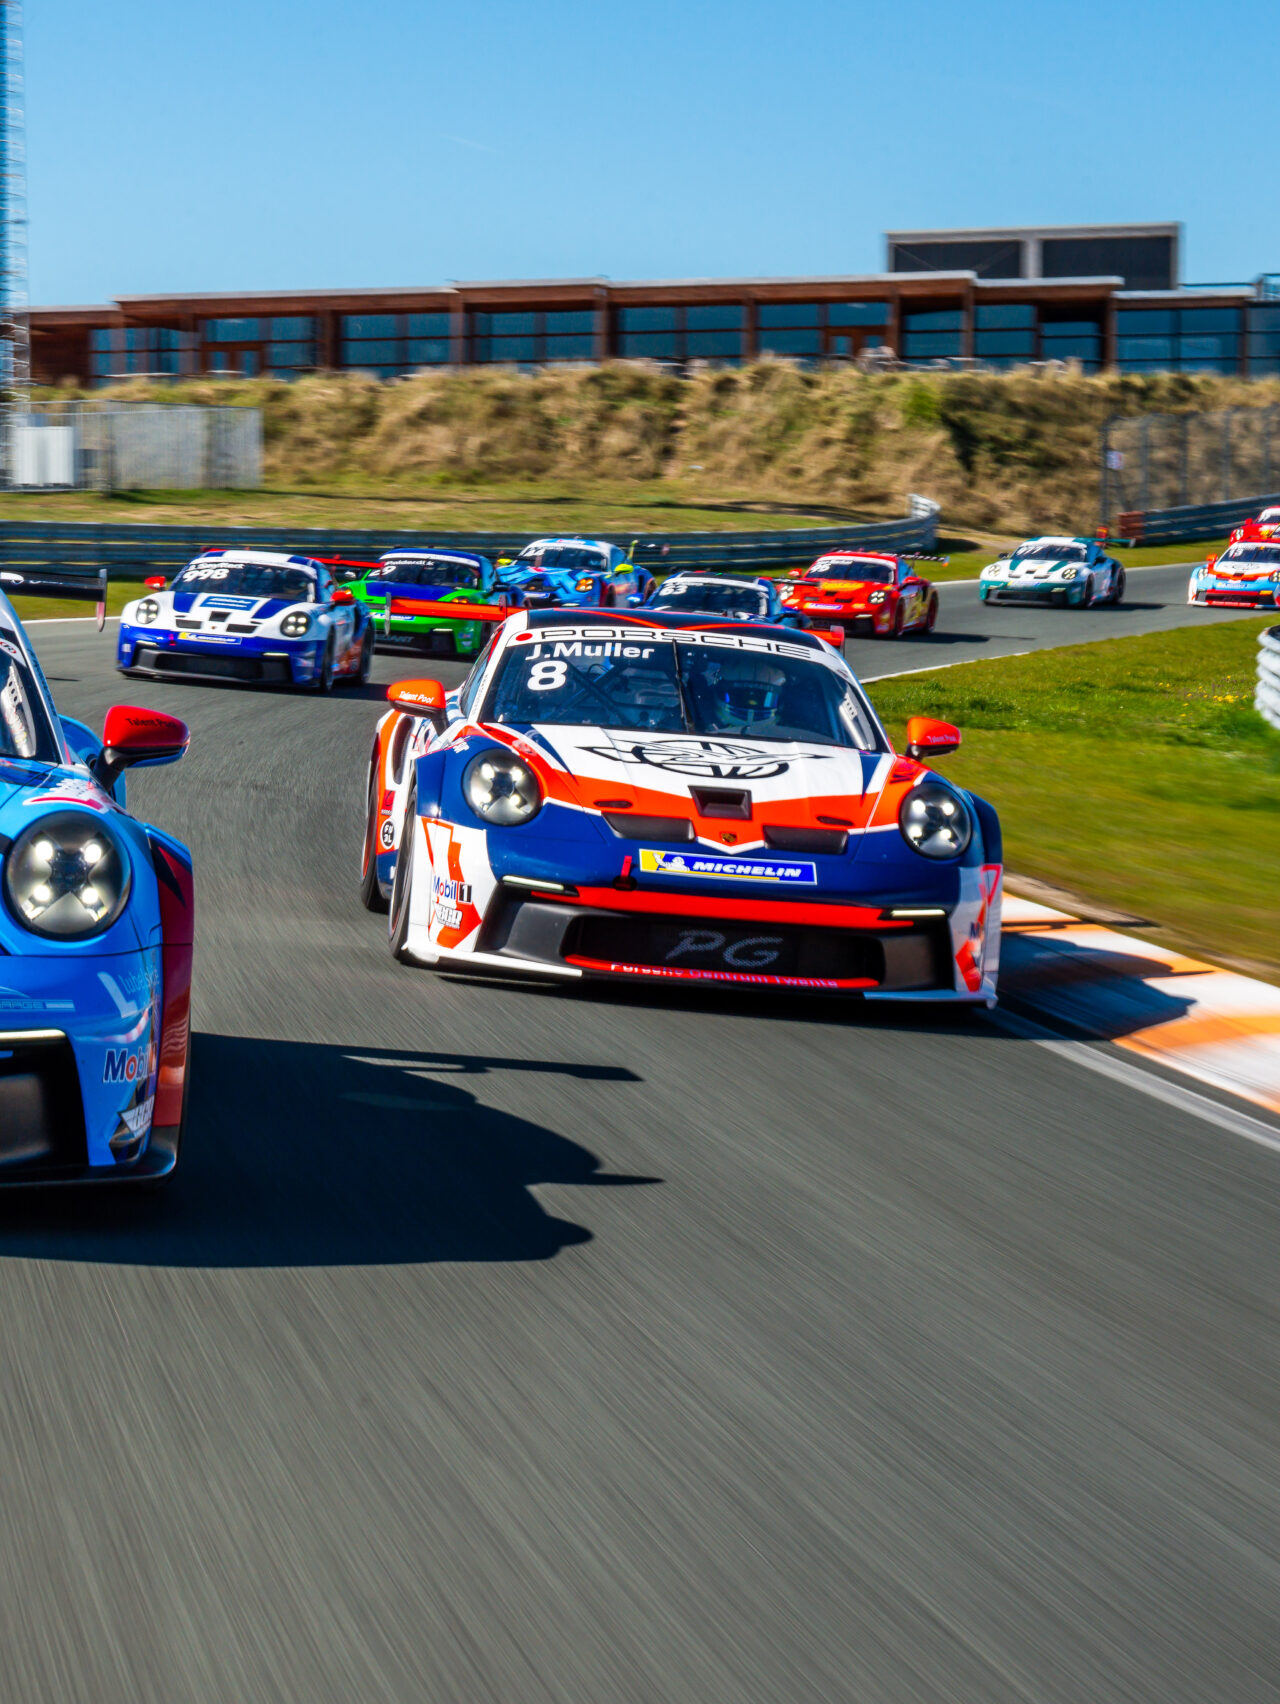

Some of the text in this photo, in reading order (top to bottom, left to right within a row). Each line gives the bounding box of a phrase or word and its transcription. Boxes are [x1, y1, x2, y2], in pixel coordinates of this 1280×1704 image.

[183, 568, 230, 583] 998
[525, 642, 655, 661] J.Muller
[540, 629, 810, 659] PORSCHE
[527, 660, 568, 691] 8
[417, 693, 435, 704] Pool
[692, 861, 803, 878] MICHELIN
[433, 875, 457, 900] Mobil
[665, 929, 784, 968] PG
